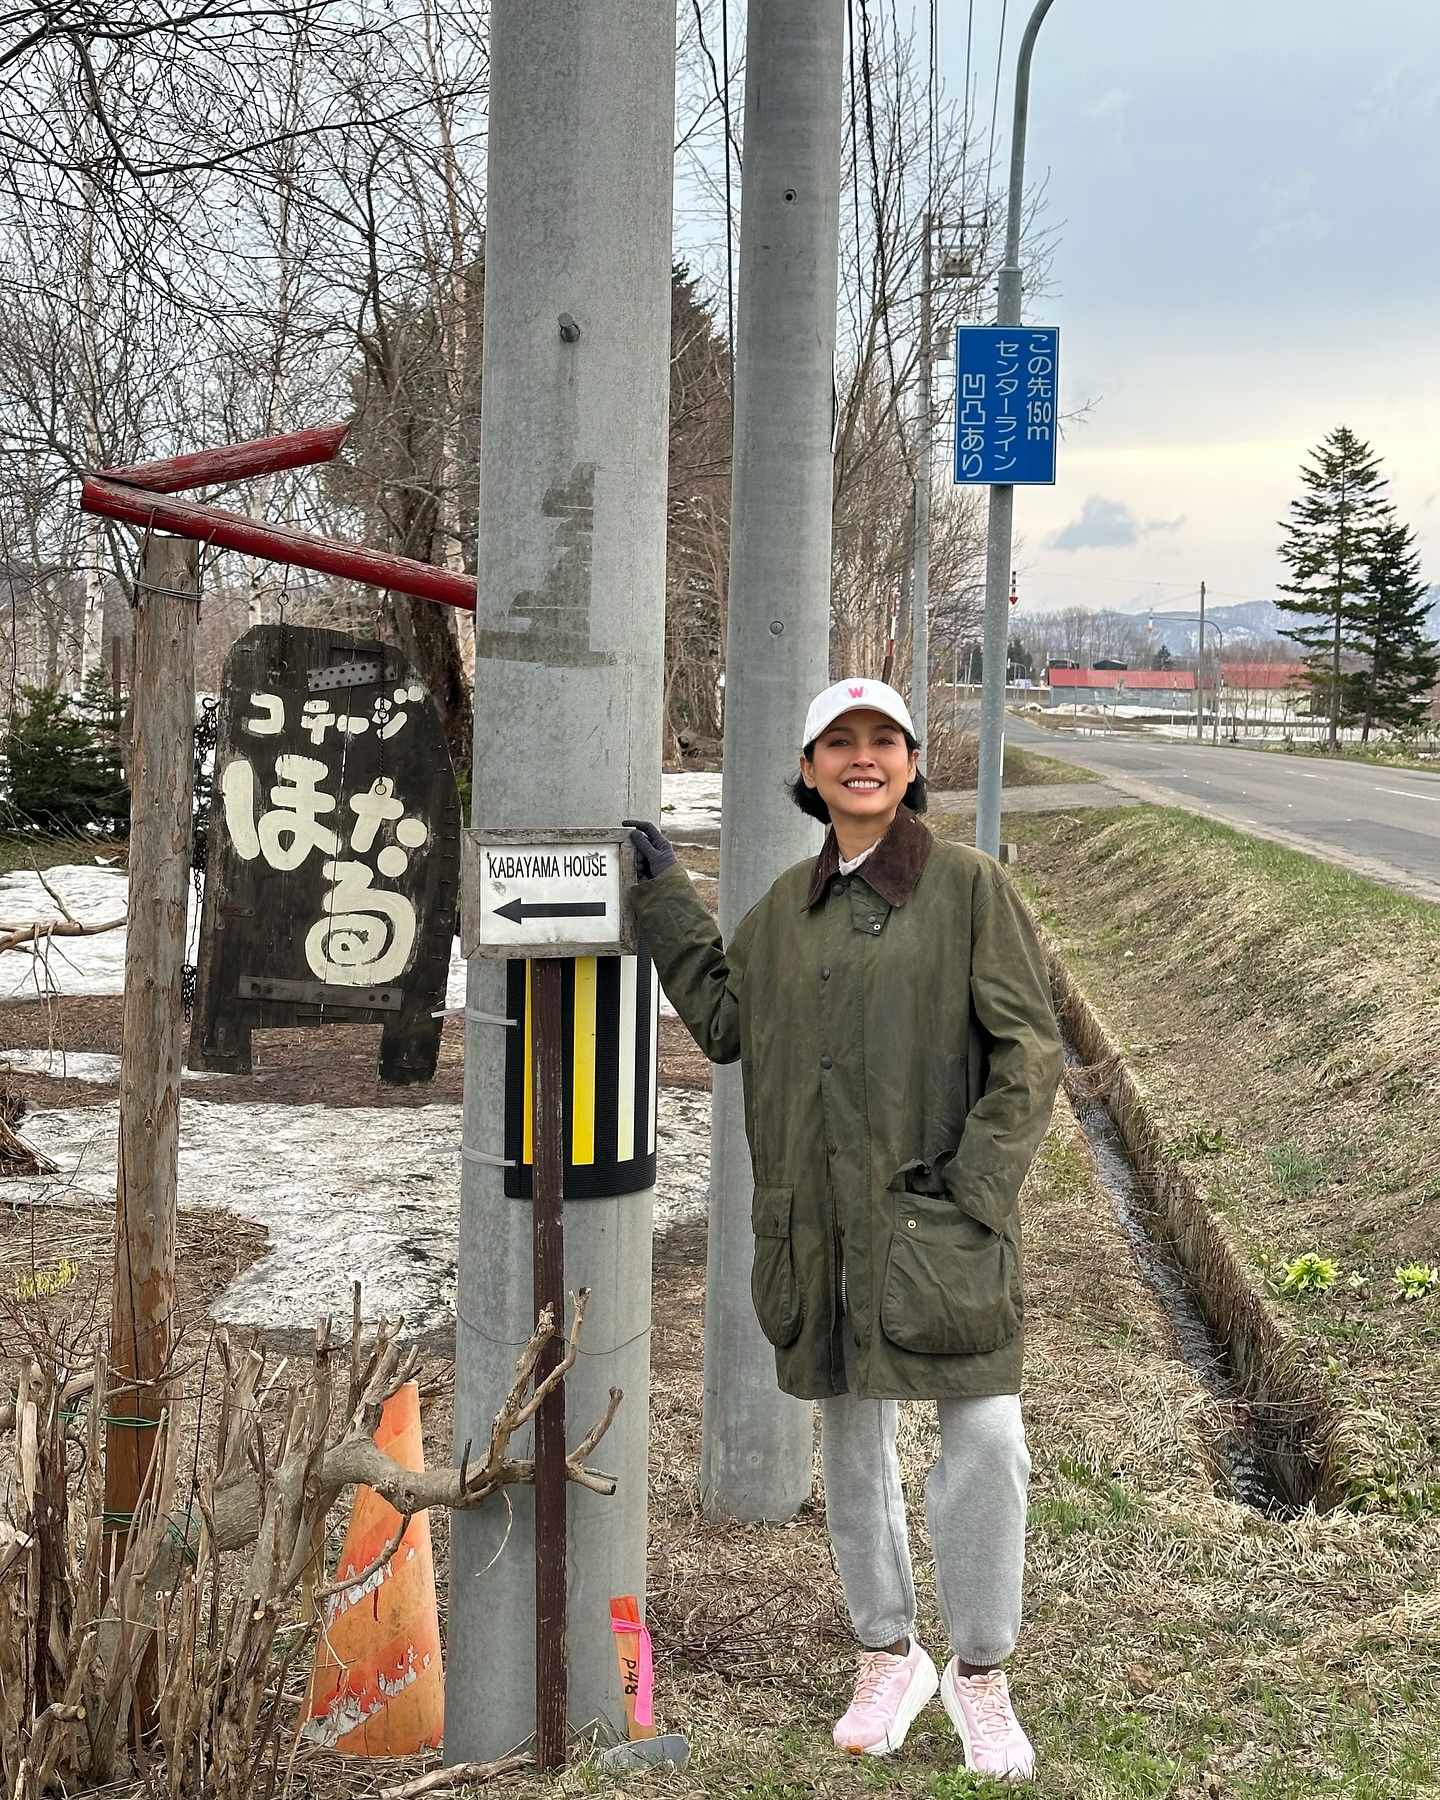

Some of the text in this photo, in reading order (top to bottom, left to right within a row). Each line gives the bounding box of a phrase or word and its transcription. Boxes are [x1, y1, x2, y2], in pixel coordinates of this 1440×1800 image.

[960, 374, 986, 477] 凹凸あり
[994, 340, 1019, 471] センターライン
[248, 686, 424, 745] コテージ
[848, 686, 864, 698] W
[489, 855, 607, 878] KABAYAMA HOUSE
